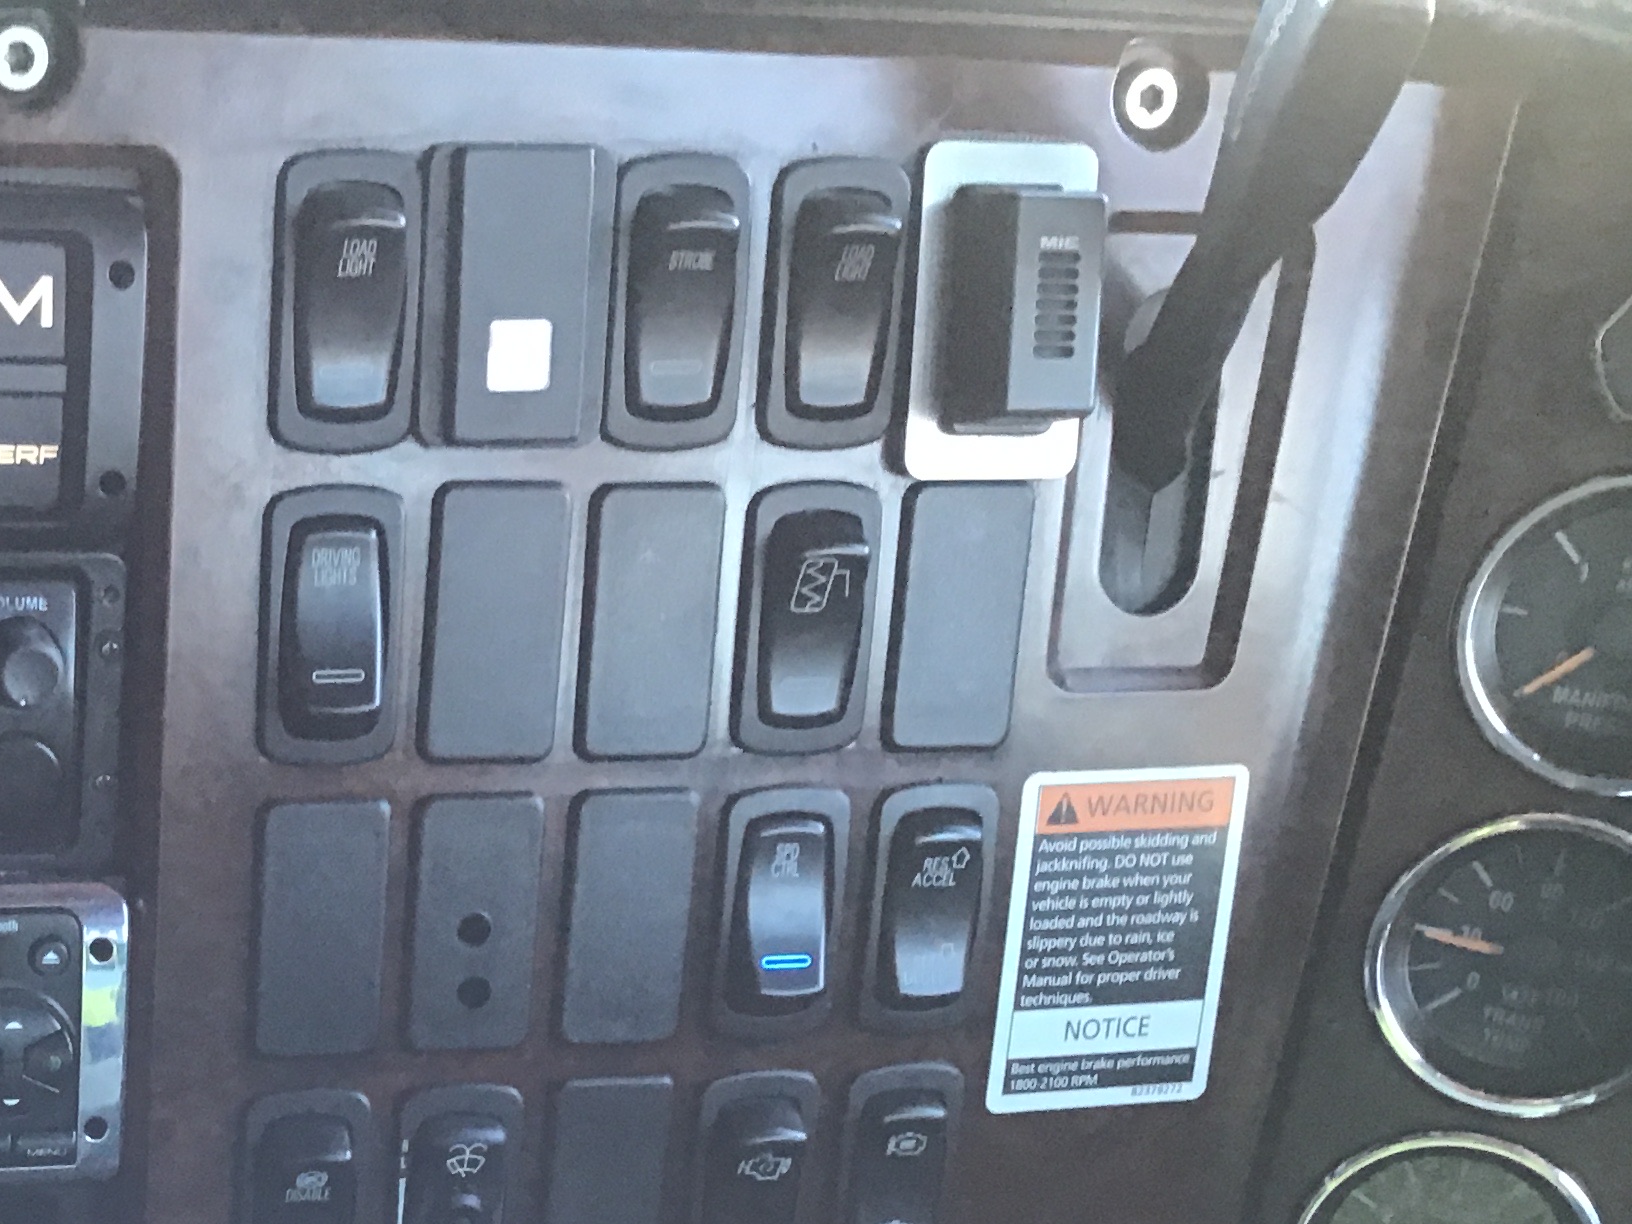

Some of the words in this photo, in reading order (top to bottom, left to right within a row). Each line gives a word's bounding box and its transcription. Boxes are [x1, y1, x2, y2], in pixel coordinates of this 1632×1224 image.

[343, 238, 378, 258] LOAD
[336, 257, 377, 278] LIGHT
[311, 547, 361, 568] DRIVING
[314, 566, 357, 588] LIGHTS
[1087, 790, 1215, 818] WARNING
[1038, 837, 1077, 853] Avoid
[1079, 834, 1131, 853] possible
[1134, 832, 1189, 850] skidding
[1192, 831, 1217, 846] and
[1035, 857, 1110, 876] jackknifing.
[1114, 854, 1137, 868] DO
[1140, 852, 1170, 867] NOT
[1171, 854, 1193, 867] use
[1034, 878, 1079, 895] engine
[1082, 874, 1119, 889] brake
[1123, 873, 1160, 888] when
[1162, 873, 1193, 889] your
[1032, 896, 1076, 911] vehicle
[1079, 894, 1089, 908] is
[1091, 893, 1133, 911] empty
[1136, 894, 1150, 906] or
[1153, 889, 1194, 906] lightly
[1029, 914, 1074, 931] loaded
[1077, 912, 1103, 928] and
[1106, 911, 1127, 926] the
[1130, 909, 1187, 927] roadway
[1189, 907, 1199, 922] is
[1027, 935, 1077, 952] slippery
[1079, 933, 1105, 948] due
[1108, 932, 1122, 946] to
[1124, 931, 1153, 946] rain,
[1156, 930, 1175, 944] ice
[1024, 957, 1039, 969] or
[1042, 953, 1078, 968] snow.
[1082, 951, 1105, 966] See
[1108, 948, 1176, 966] Operator's
[1022, 972, 1072, 988] Manual
[1075, 970, 1094, 986] for
[1096, 969, 1141, 987] proper
[1143, 966, 1182, 981] driver
[1064, 1014, 1151, 1042] NOTICE
[1010, 1062, 1036, 1076] Best
[1037, 1060, 1079, 1076] engine
[1081, 1056, 1115, 1071] brake
[1117, 1053, 1191, 1071] performance
[1070, 1074, 1099, 1088] RPM
